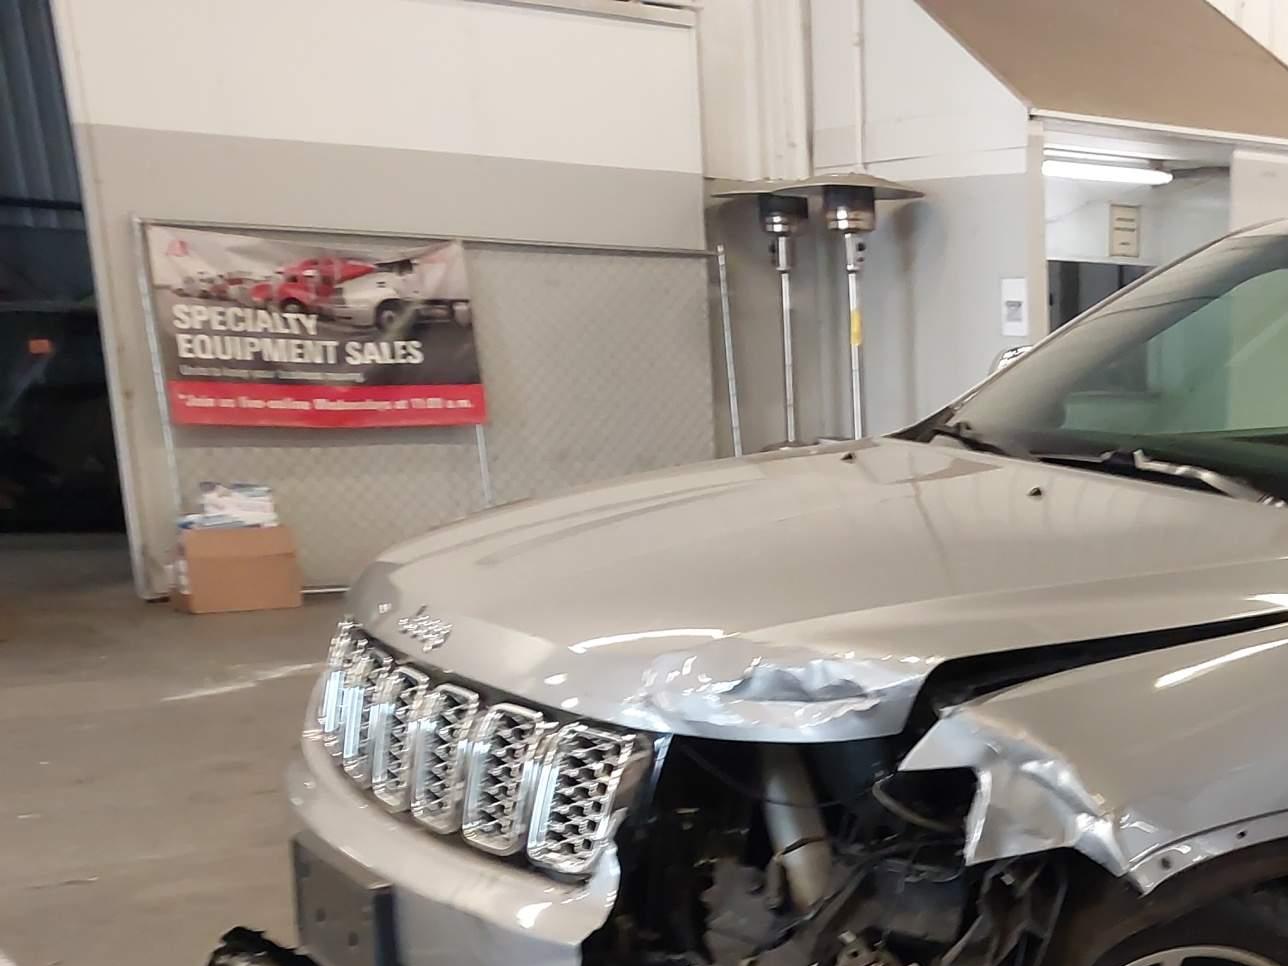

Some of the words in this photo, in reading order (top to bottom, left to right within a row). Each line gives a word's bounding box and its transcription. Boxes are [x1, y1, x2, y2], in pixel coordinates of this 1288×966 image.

[172, 304, 319, 335] SPECIALTY
[176, 333, 339, 364] EQUIPMENT
[344, 340, 425, 366] SALES
